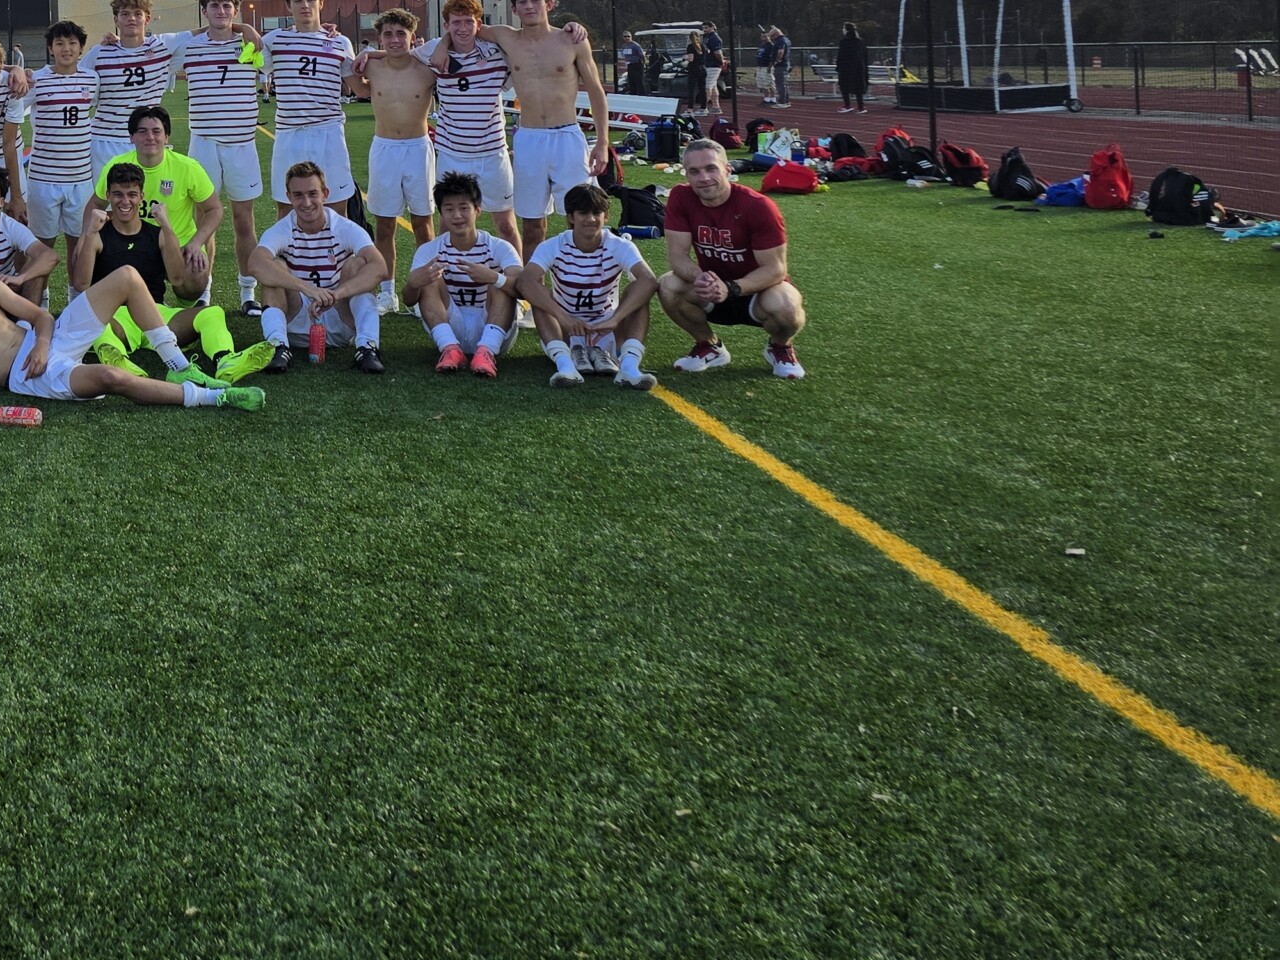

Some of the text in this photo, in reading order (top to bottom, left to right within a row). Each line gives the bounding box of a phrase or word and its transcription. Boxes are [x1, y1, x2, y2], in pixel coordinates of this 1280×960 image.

[217, 66, 228, 85] 7
[299, 56, 317, 76] 21
[123, 66, 145, 87] 29
[63, 106, 79, 125] 18
[458, 289, 477, 306] 17
[575, 290, 594, 311] 14
